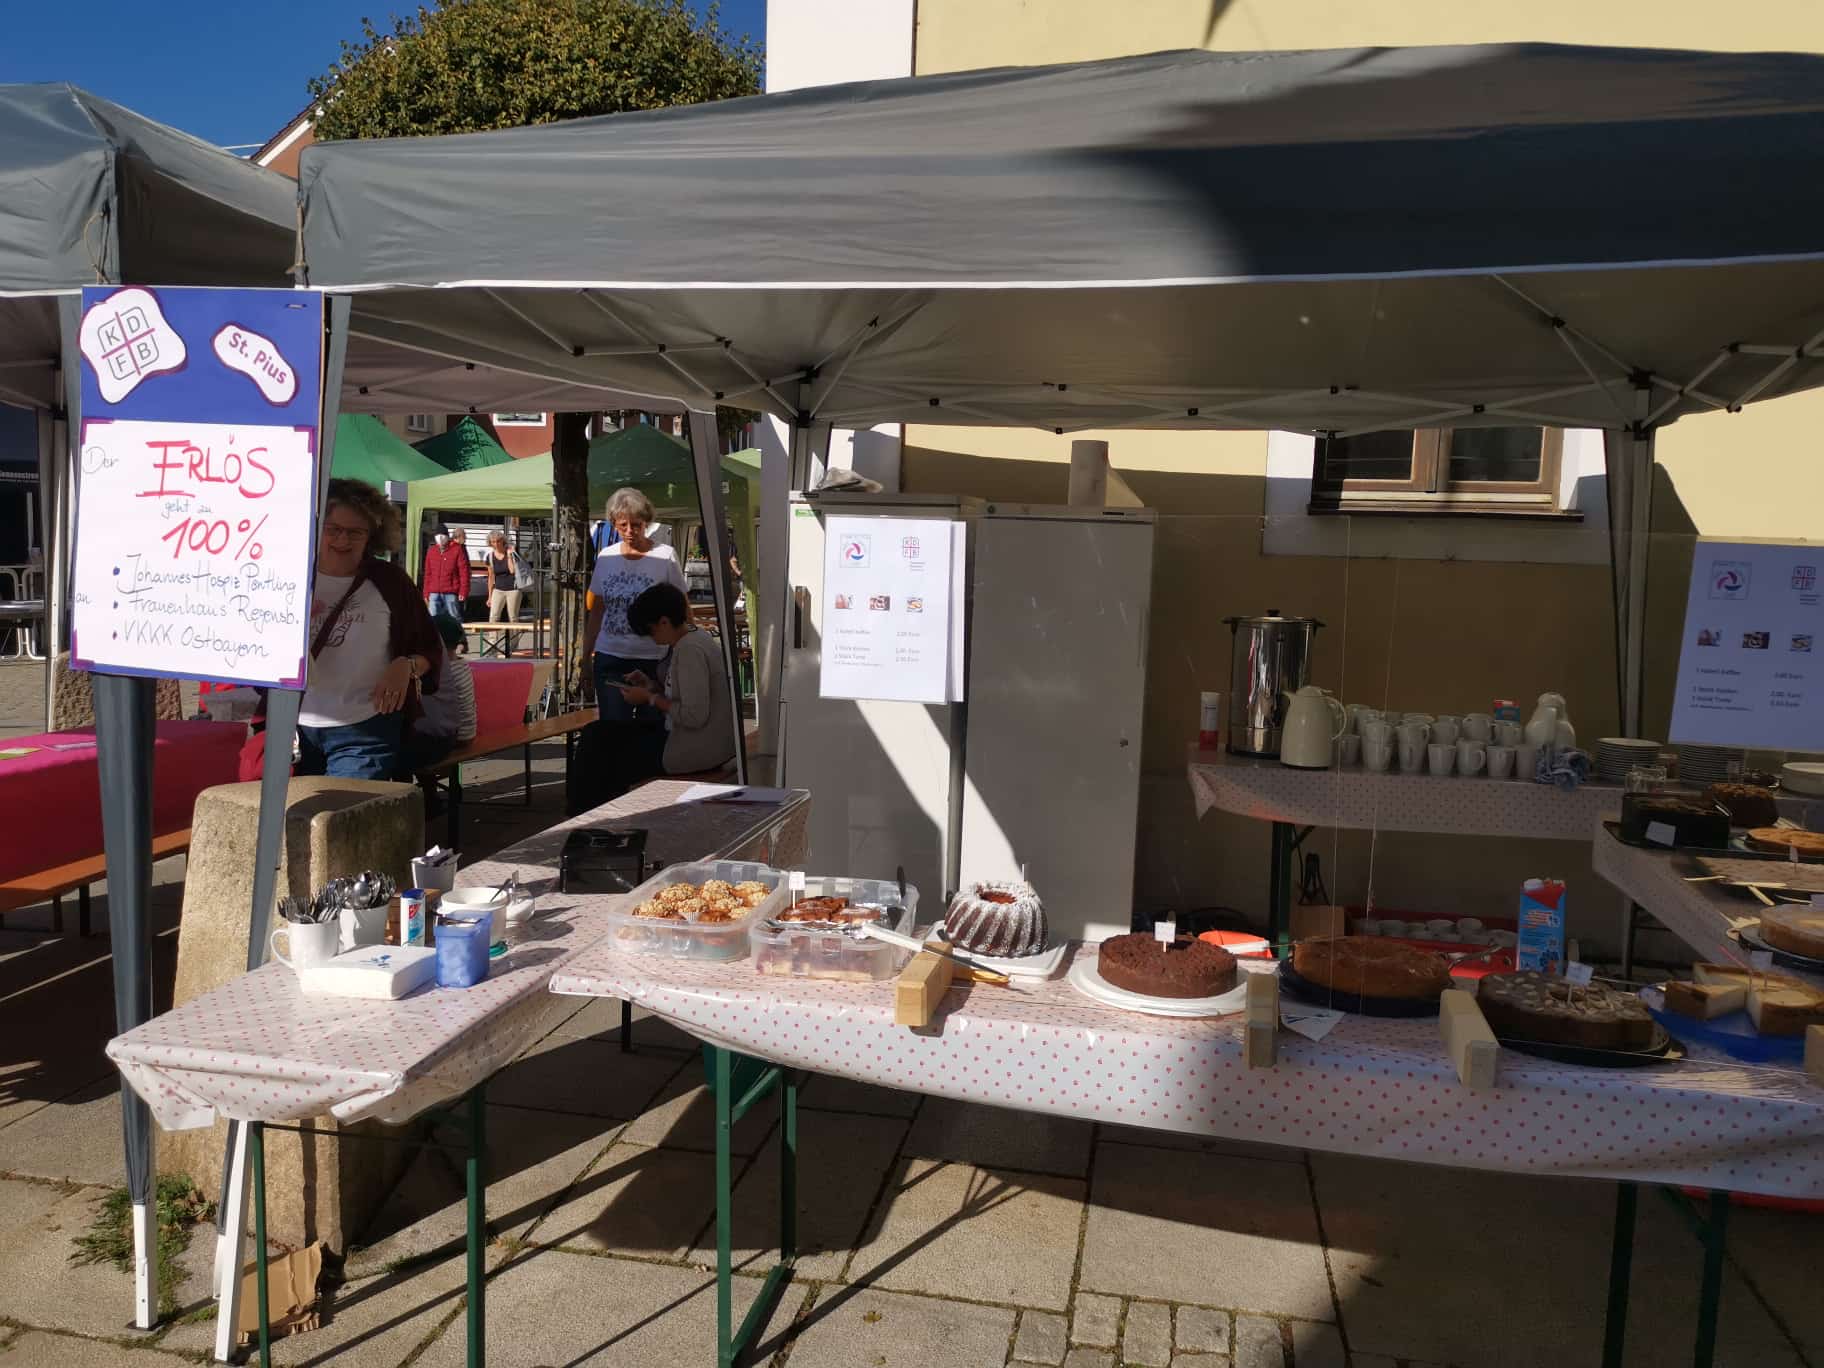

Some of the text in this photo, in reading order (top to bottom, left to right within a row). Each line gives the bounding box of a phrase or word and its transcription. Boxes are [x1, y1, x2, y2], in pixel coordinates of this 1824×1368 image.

[228, 331, 288, 386] St. Pius
[161, 501, 190, 520] geht
